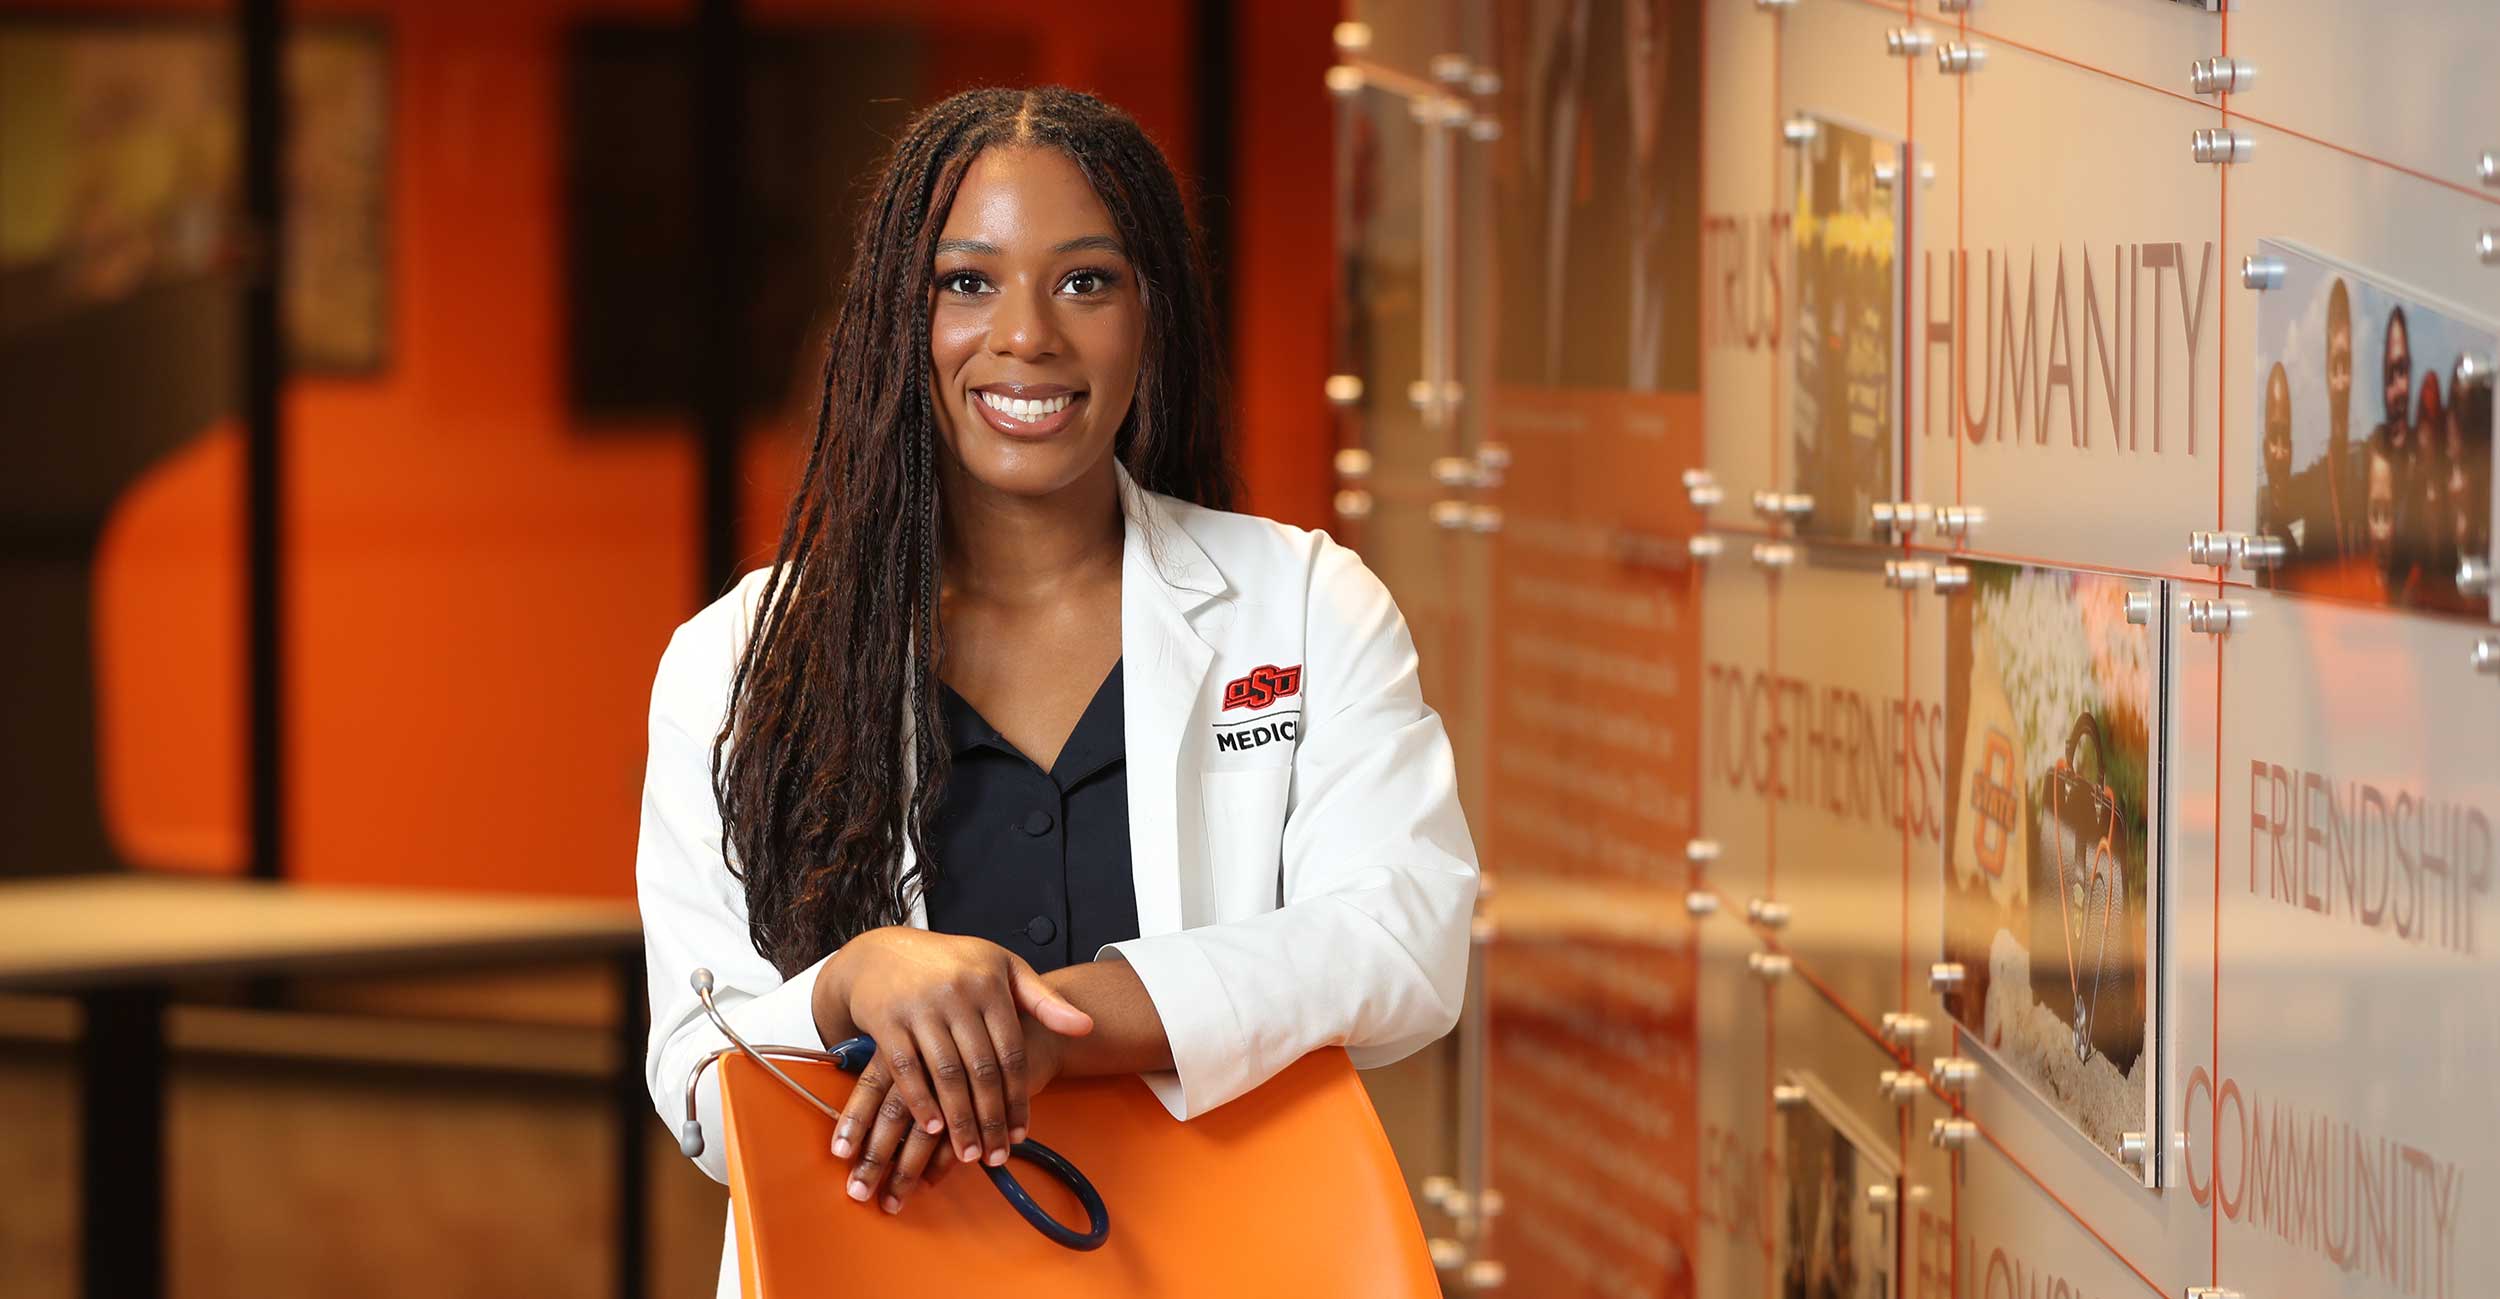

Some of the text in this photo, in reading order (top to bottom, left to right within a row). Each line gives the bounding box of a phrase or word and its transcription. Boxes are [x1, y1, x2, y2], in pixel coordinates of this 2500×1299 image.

[1925, 240, 2212, 457] HUMANITY
[1222, 664, 1302, 712] OSU
[1706, 664, 1942, 845] TOGETHERNESS
[2249, 759, 2493, 955] FRIENDSHIP
[2183, 1064, 2456, 1299] COMMUNITY
